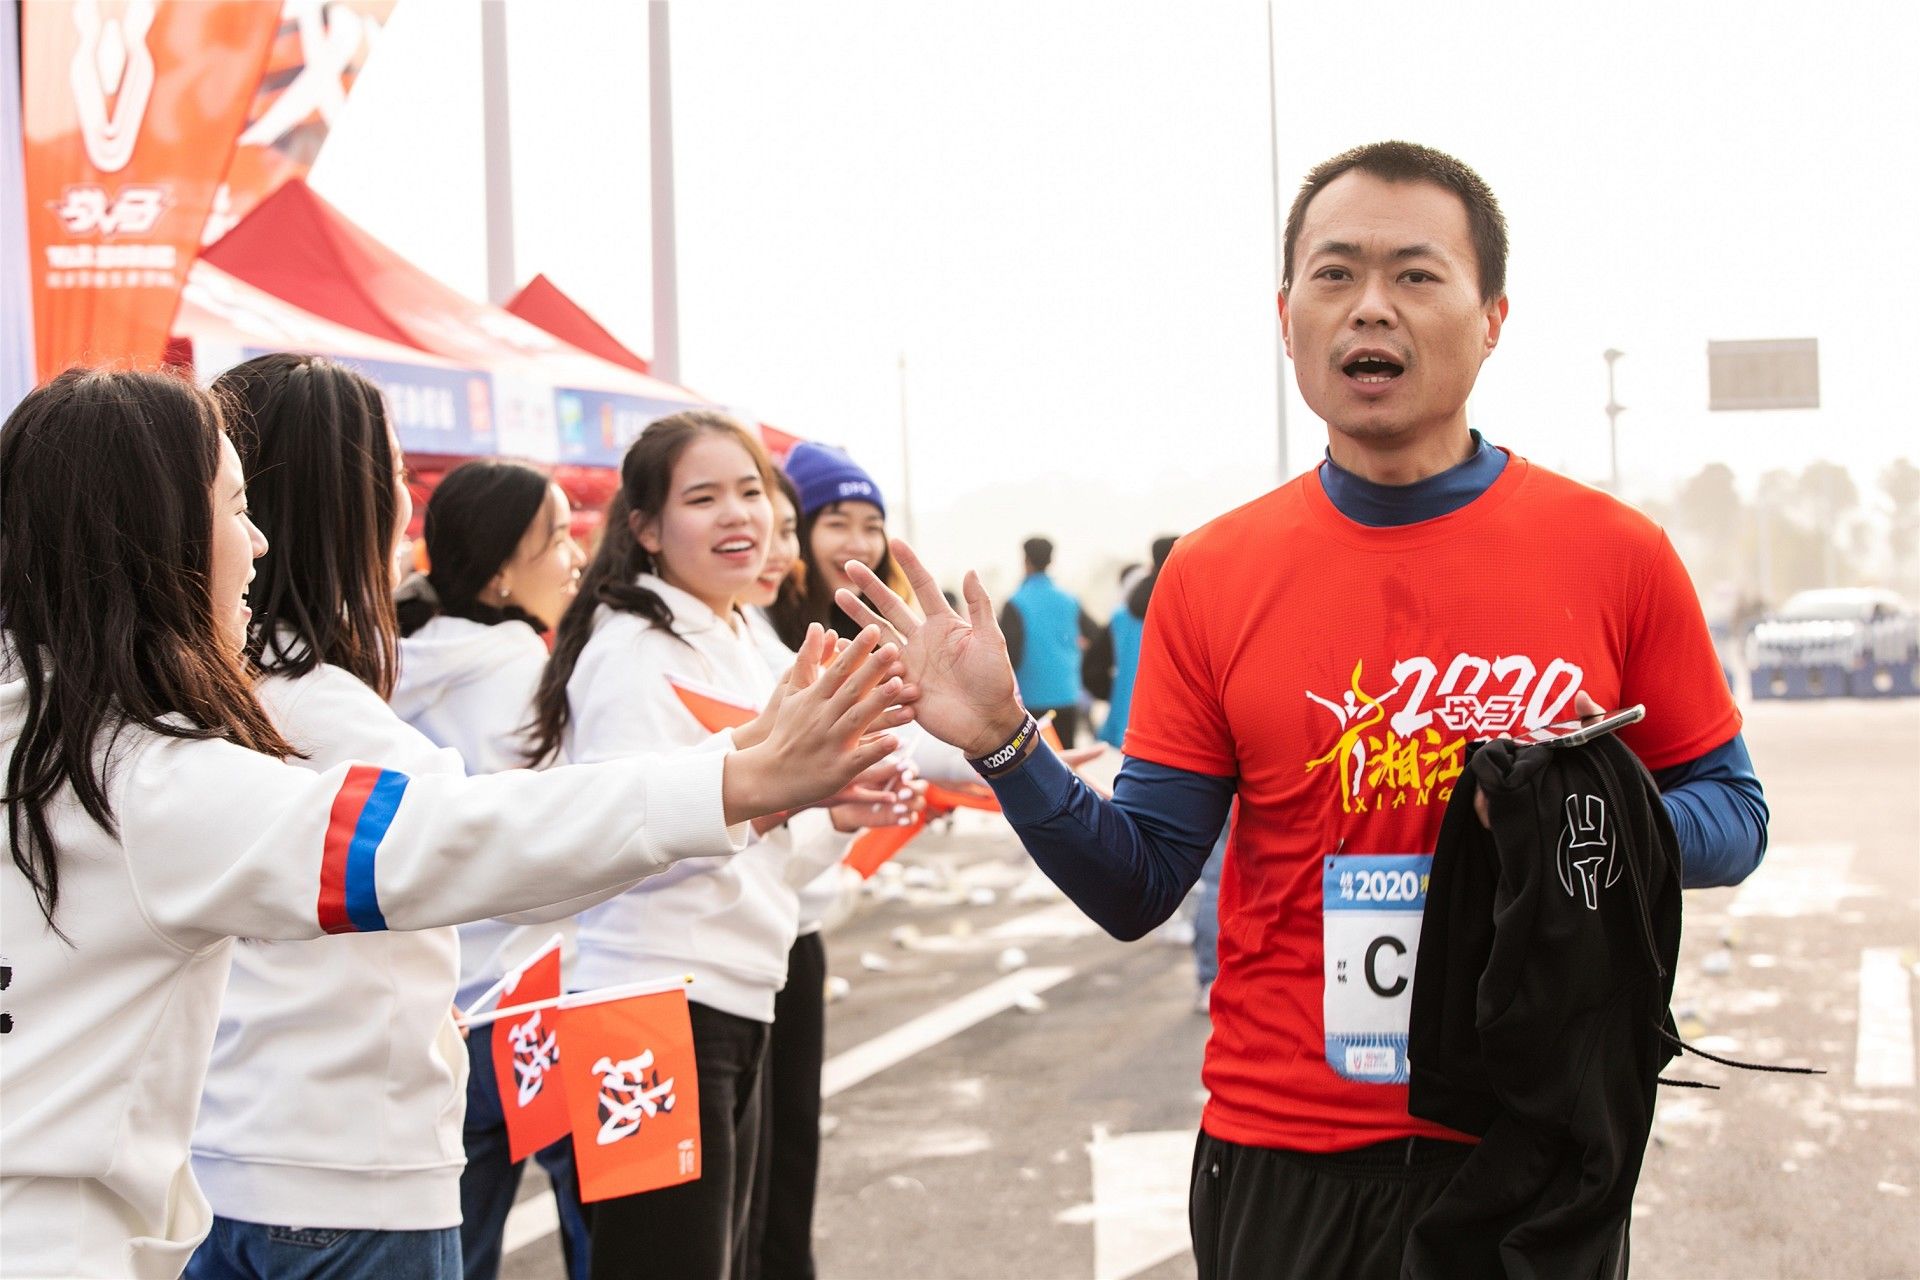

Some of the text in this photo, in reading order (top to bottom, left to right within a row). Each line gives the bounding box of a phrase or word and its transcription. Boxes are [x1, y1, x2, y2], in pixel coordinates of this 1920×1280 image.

[988, 745, 1016, 767] 2020
[1366, 730, 1466, 789] 湘江
[1355, 870, 1418, 902] 2020
[1364, 936, 1408, 998] C
